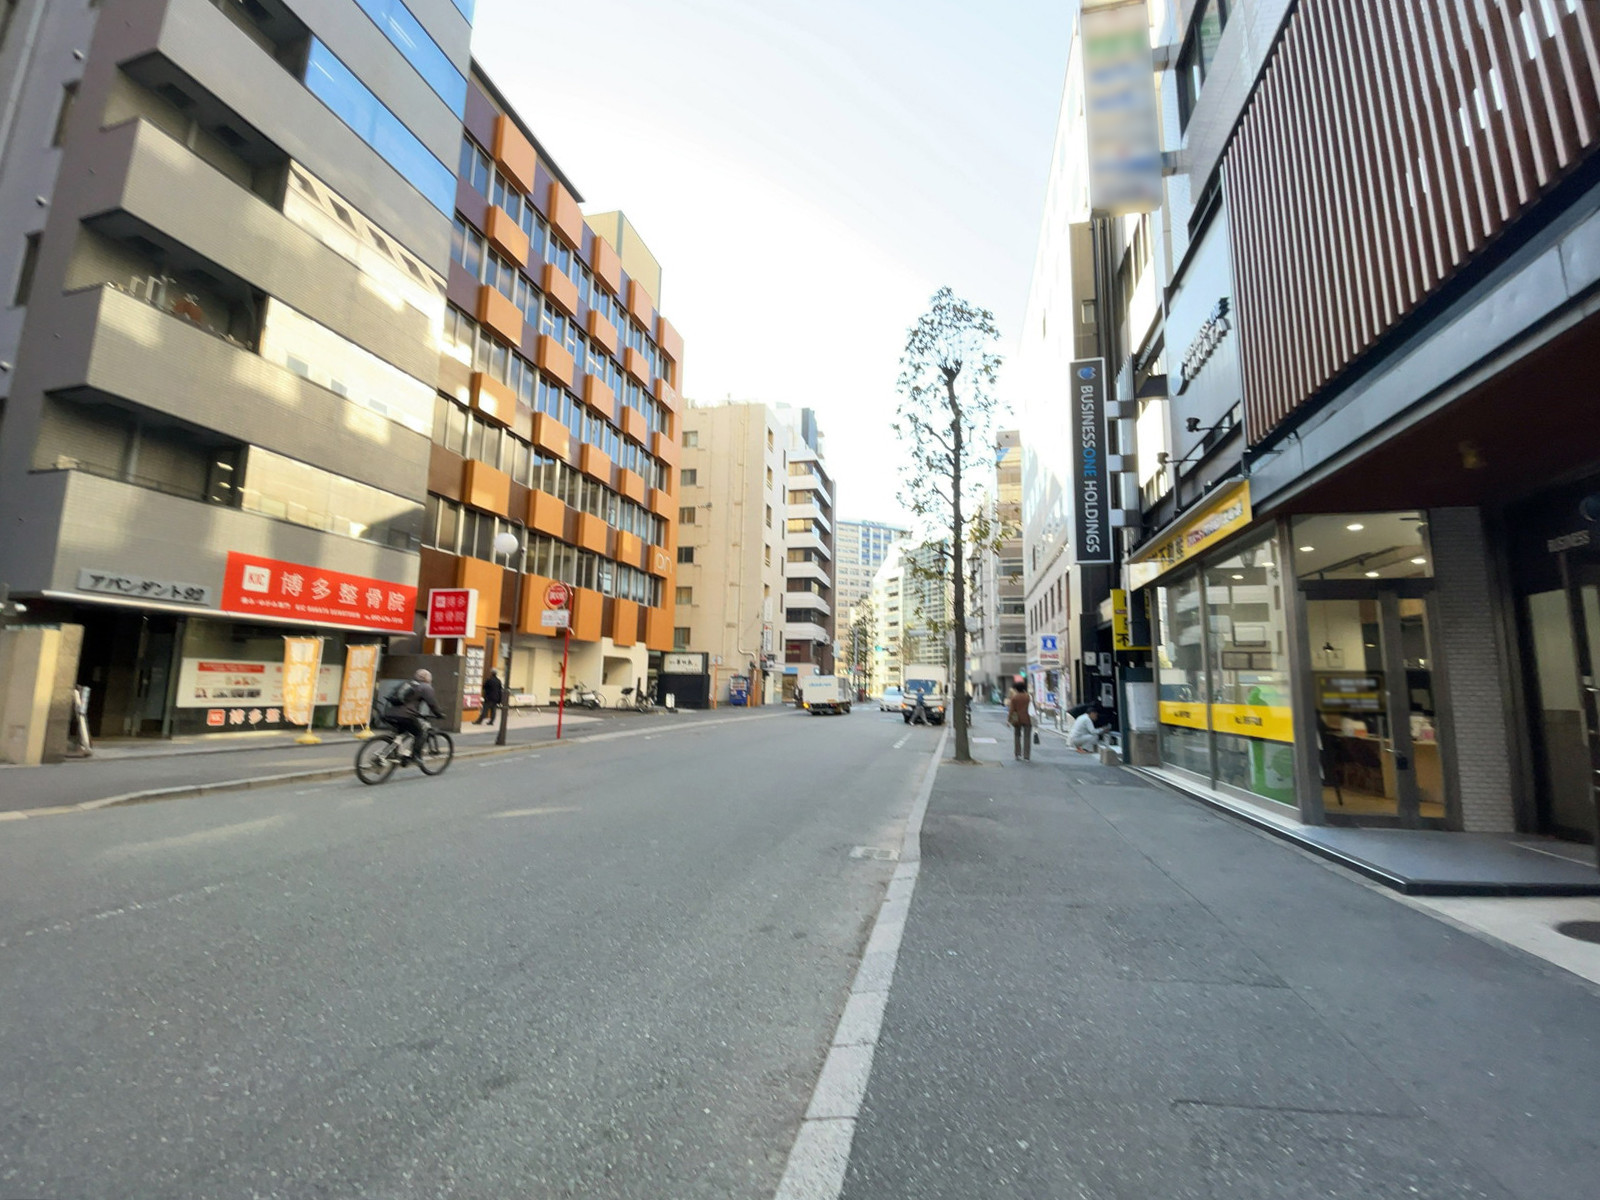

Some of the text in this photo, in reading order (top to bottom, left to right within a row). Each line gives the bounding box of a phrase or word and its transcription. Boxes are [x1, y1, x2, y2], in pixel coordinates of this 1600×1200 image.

[1080, 385, 1101, 553] BUSINESSONE HOLDINGS
[281, 571, 406, 613] 博多整骨院
